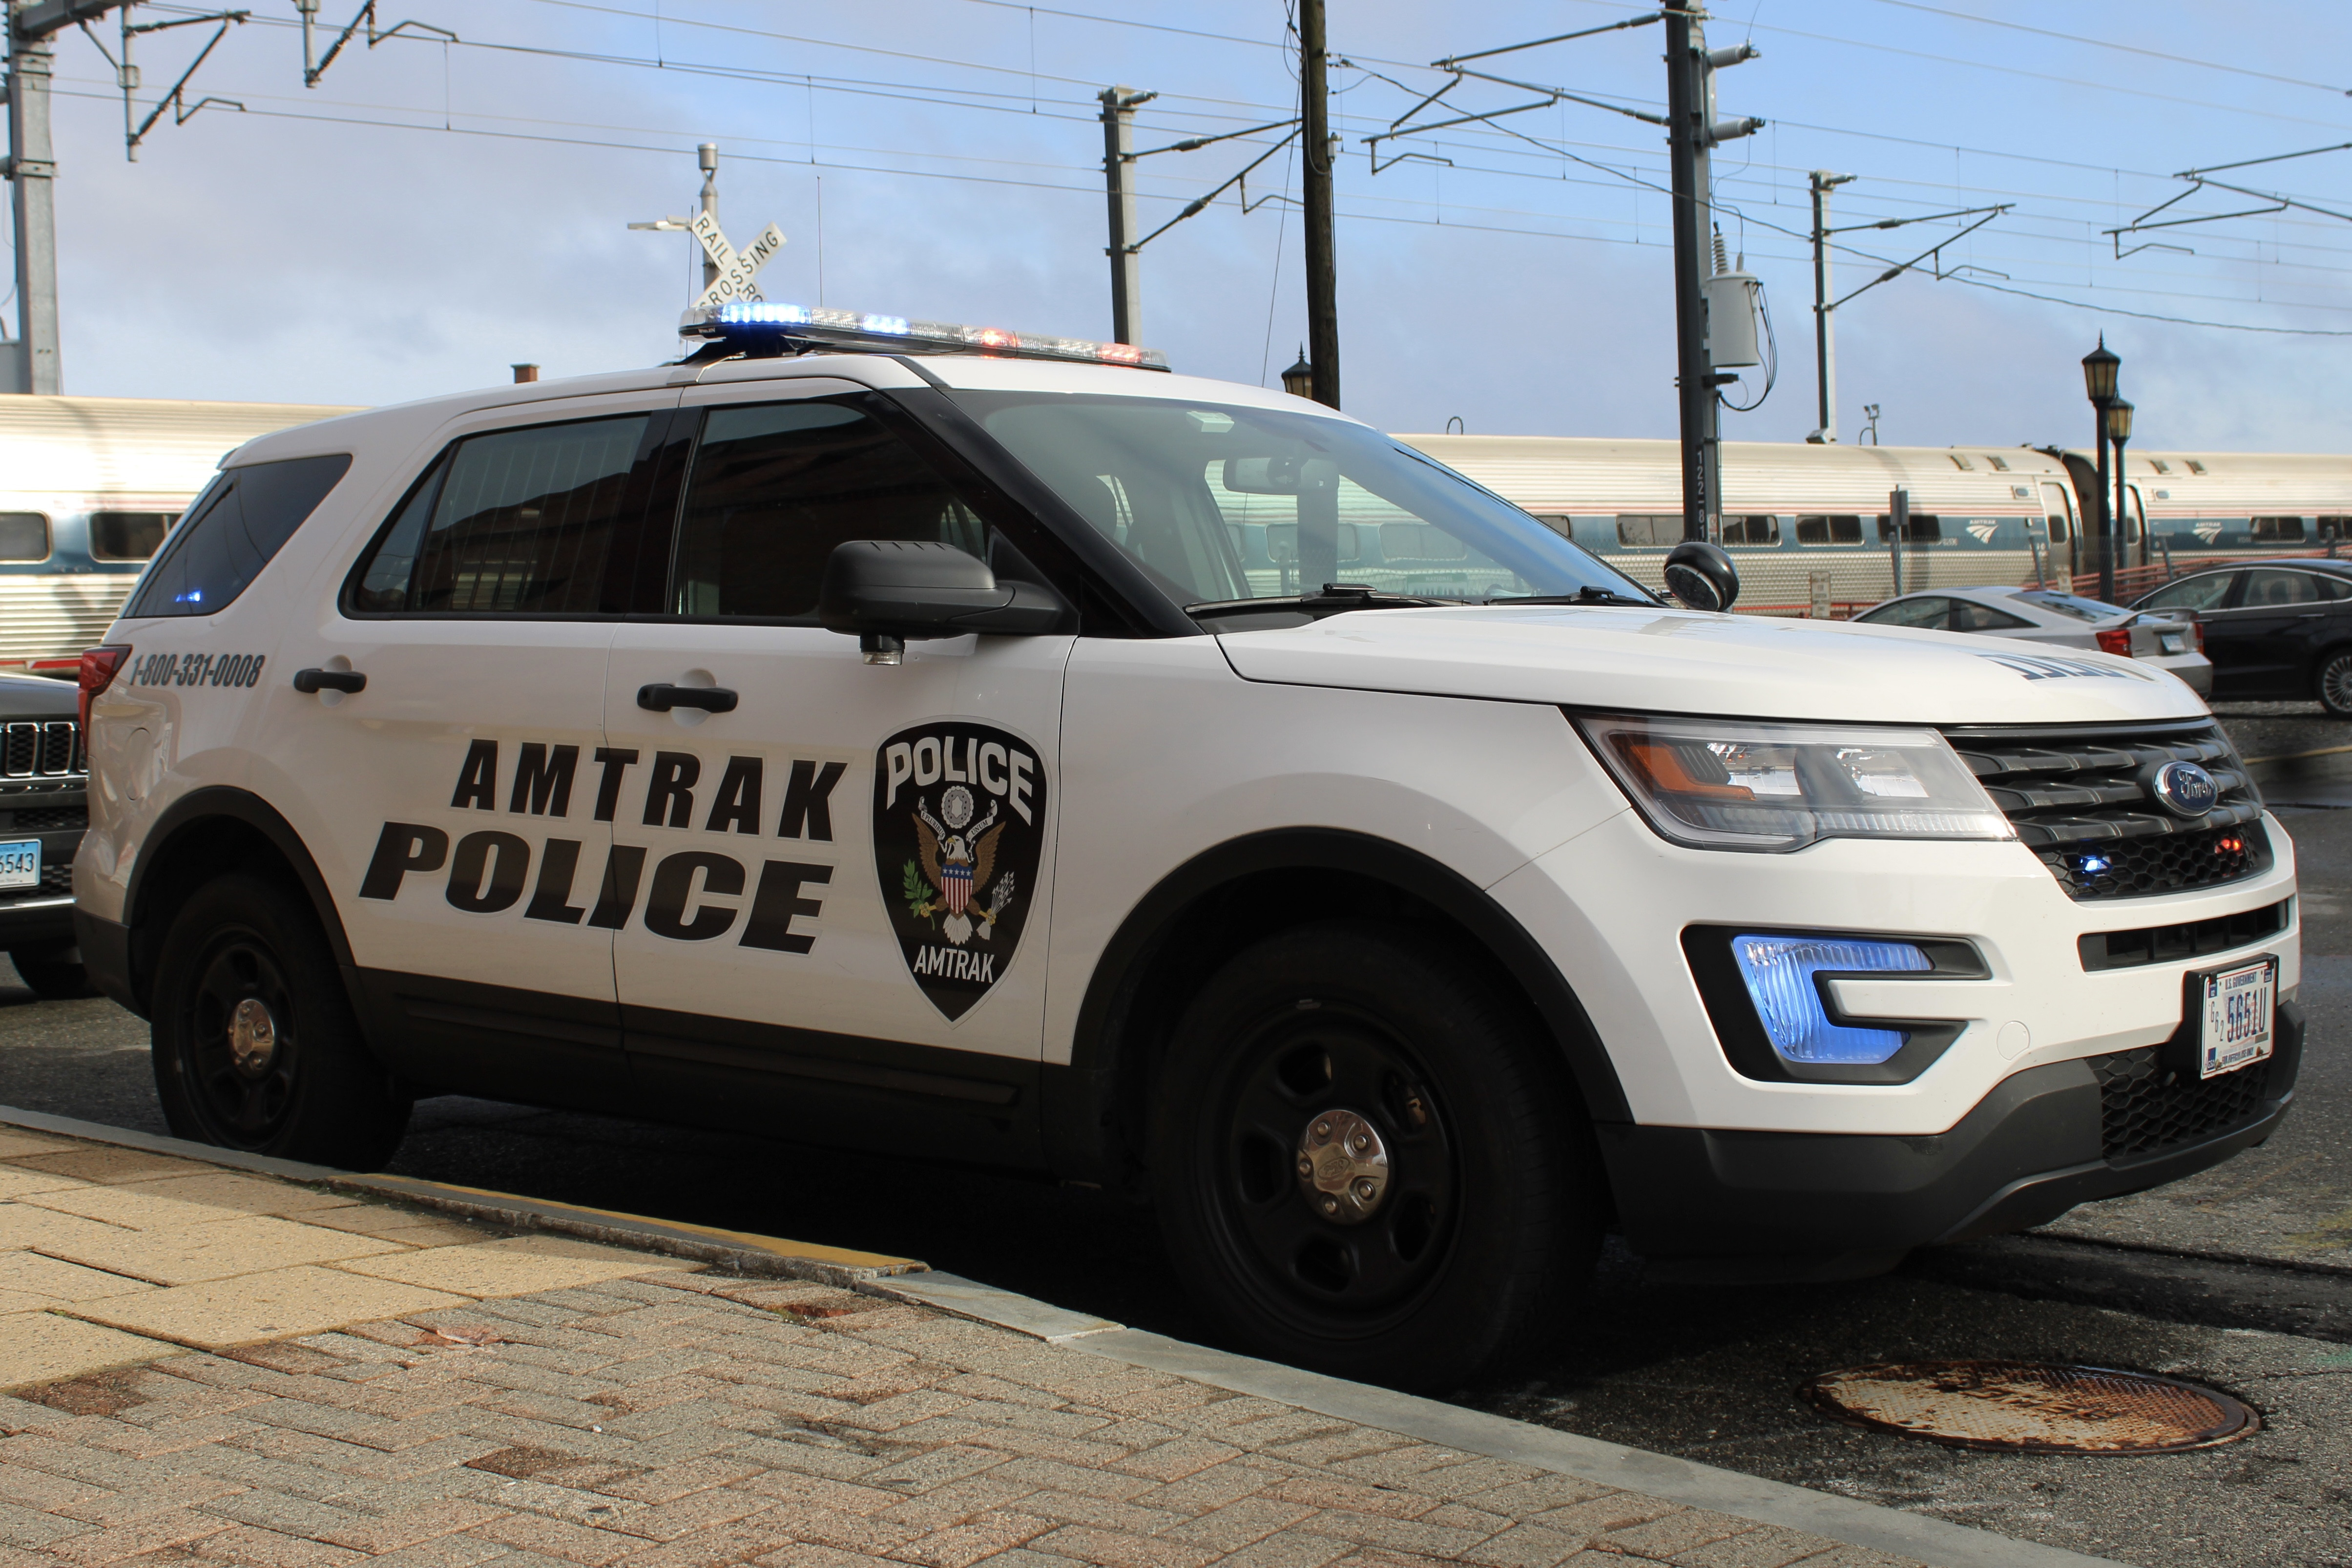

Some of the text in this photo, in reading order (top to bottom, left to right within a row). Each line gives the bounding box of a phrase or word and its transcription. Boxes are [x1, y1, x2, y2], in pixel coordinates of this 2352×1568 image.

[695, 216, 728, 265] RAIL
[1697, 450, 1705, 538] 122-81
[129, 653, 266, 688] 1-800-331-0008
[451, 738, 848, 842] AMTRAK
[886, 736, 1034, 826] POLICE
[2177, 769, 2211, 799] Ford
[925, 815, 945, 838] PLURIBUS
[971, 820, 988, 836] UNUM
[358, 821, 834, 955] POLICE
[913, 945, 995, 983] AMTRAK
[2233, 971, 2256, 988] GOVERNMENT
[2227, 986, 2267, 1043] 5651U
